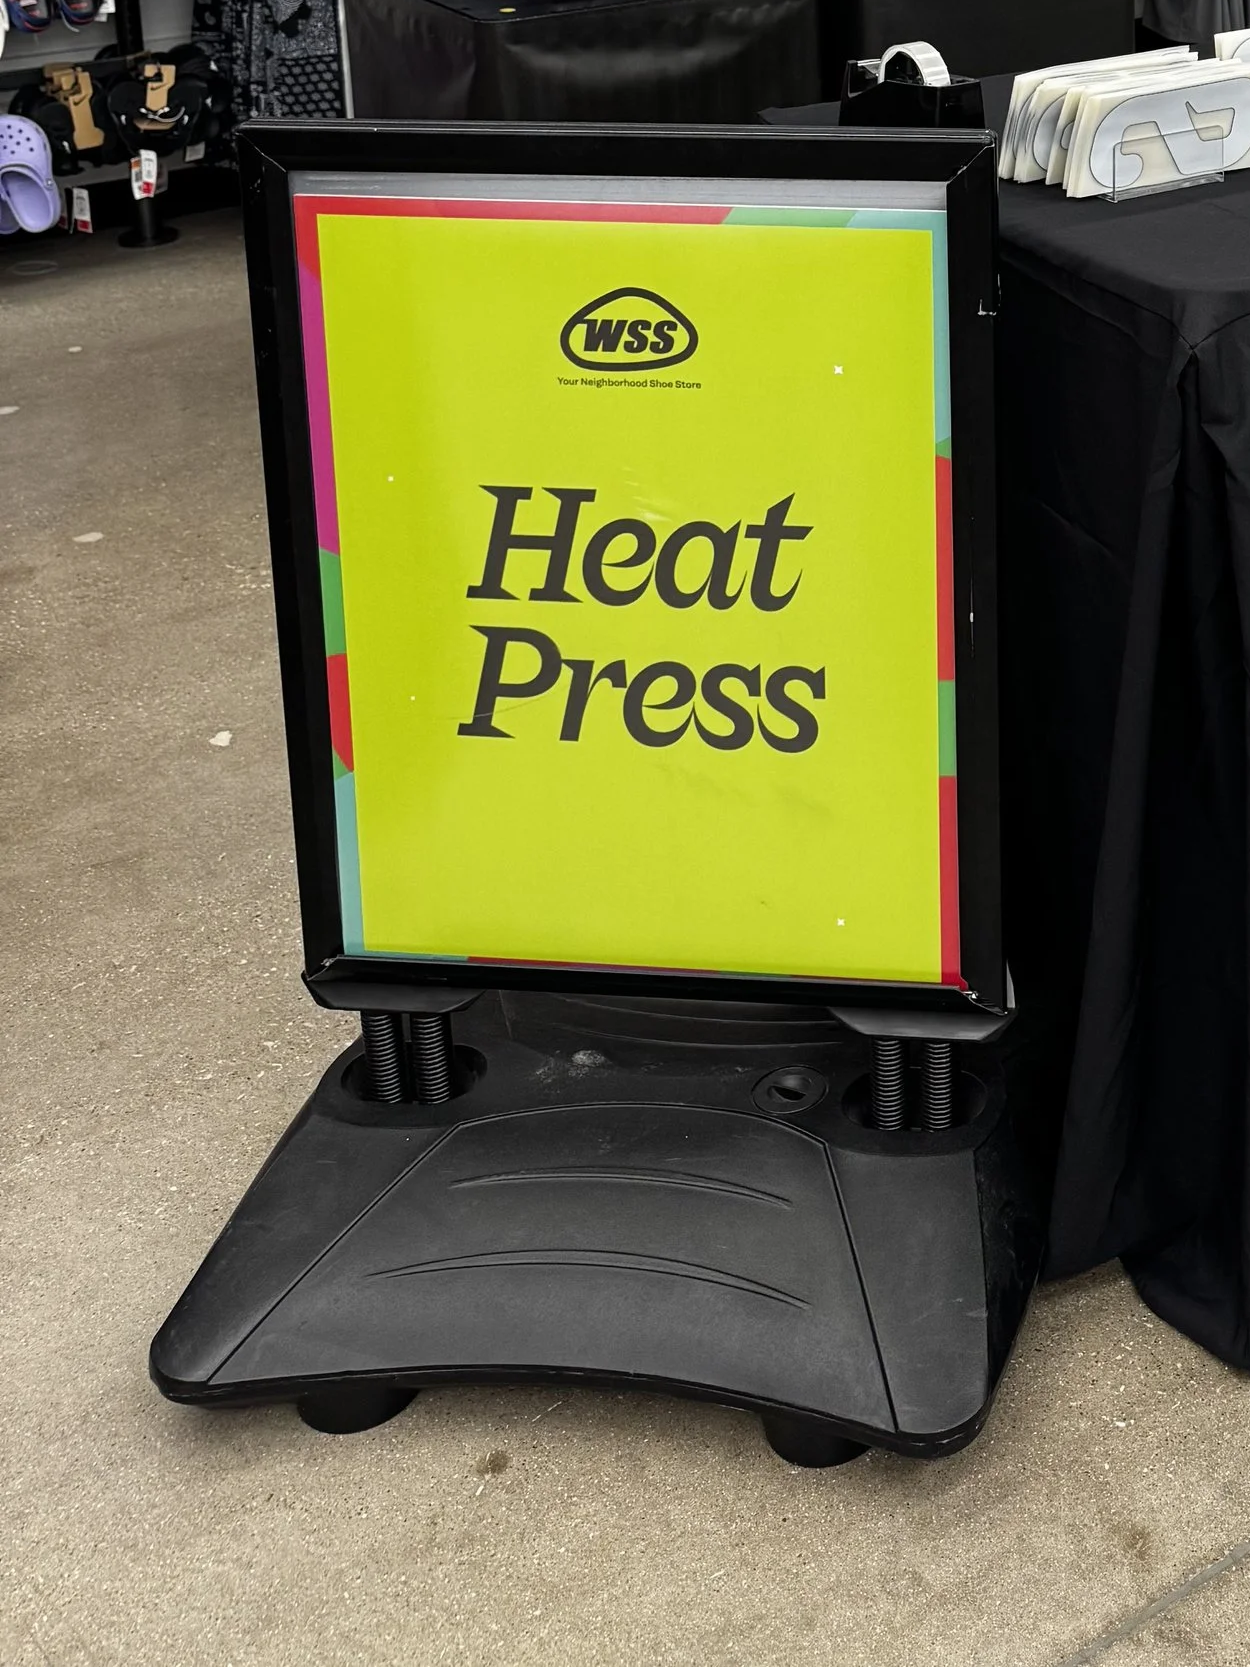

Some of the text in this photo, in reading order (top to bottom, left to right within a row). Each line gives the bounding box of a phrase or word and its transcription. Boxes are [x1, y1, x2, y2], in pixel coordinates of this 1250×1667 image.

[583, 318, 678, 354] WSS
[557, 377, 701, 389] Your Neighborhood Shoe Store
[466, 484, 813, 613] Heat
[456, 624, 827, 754] Press
